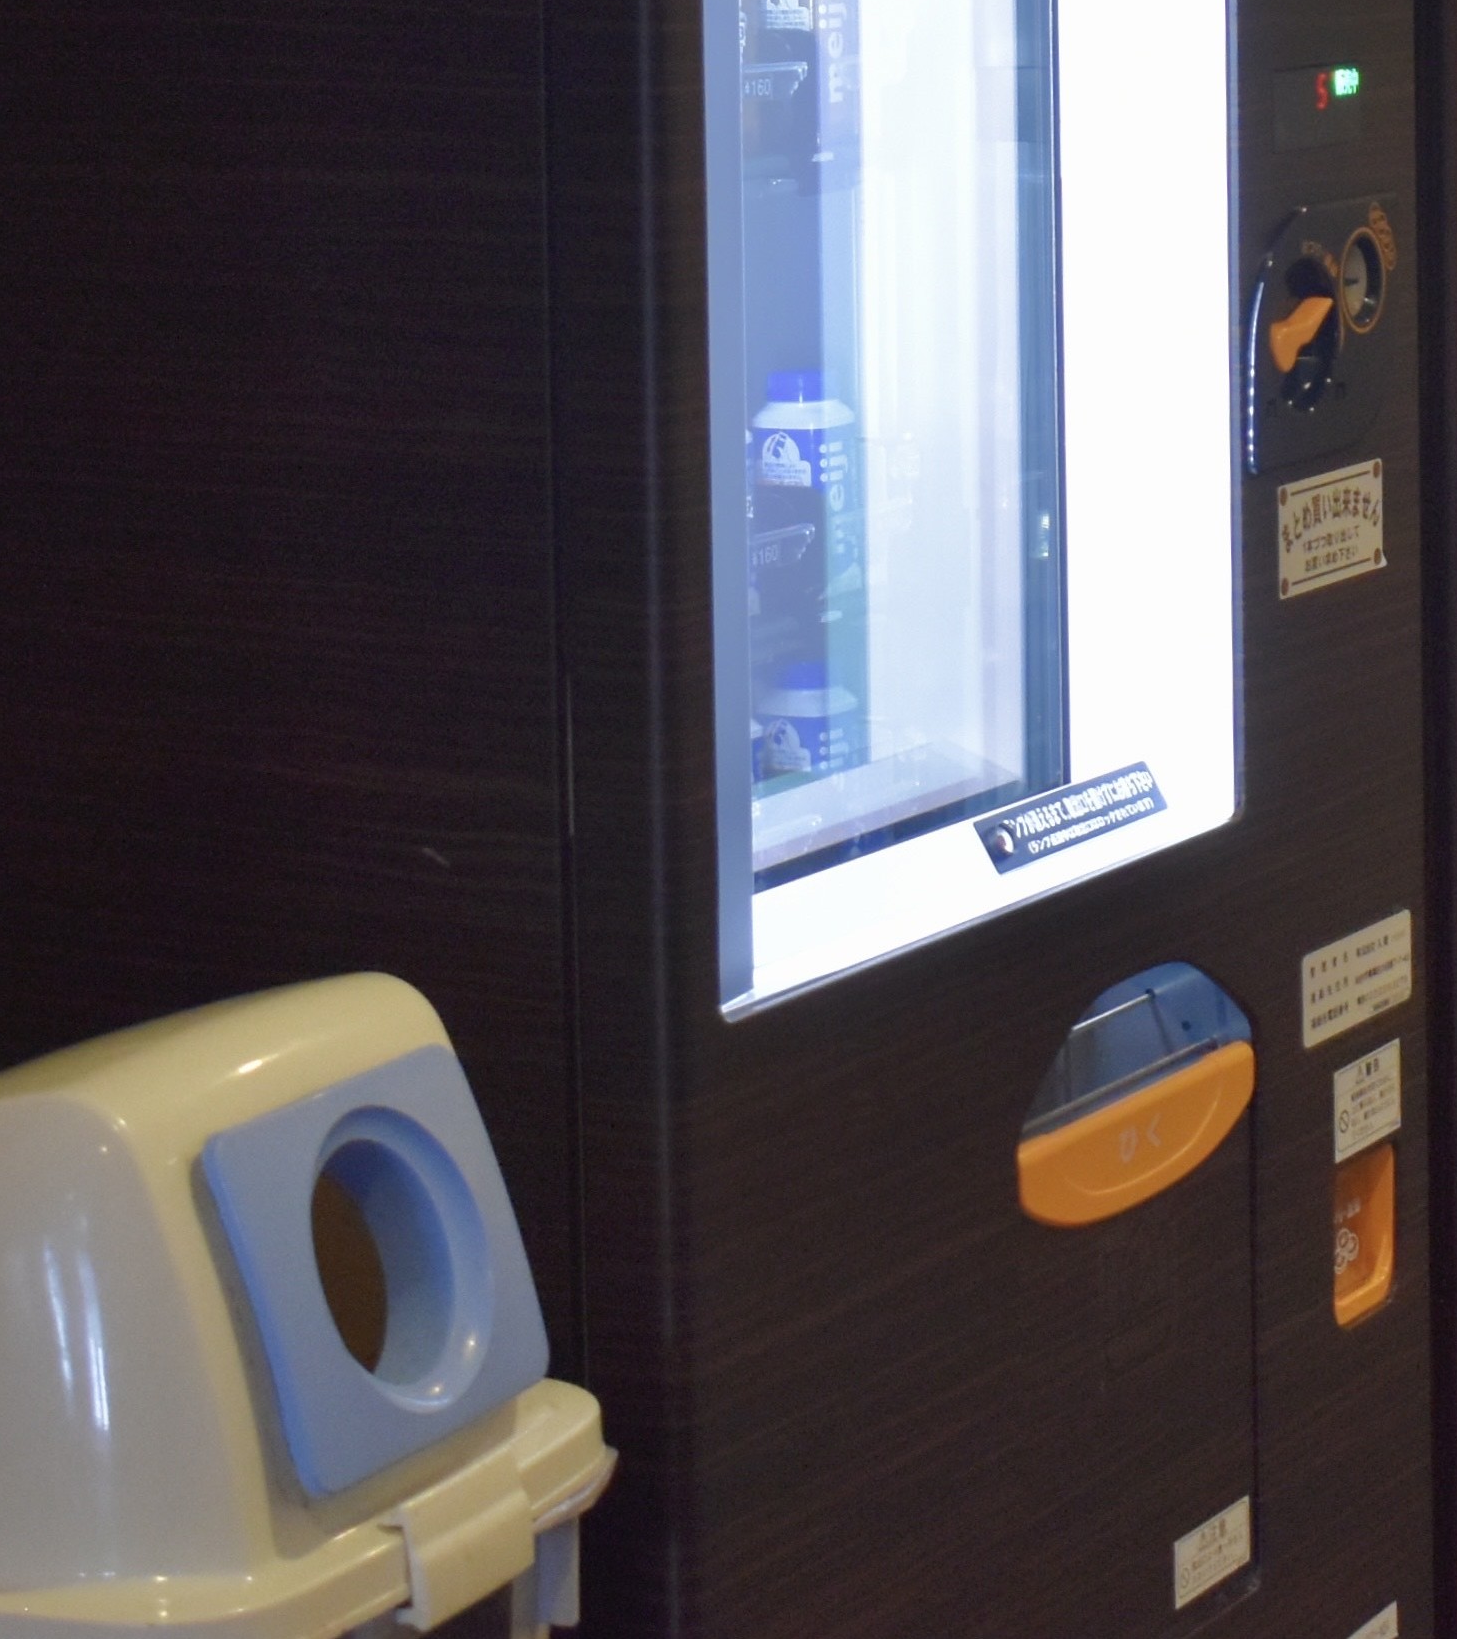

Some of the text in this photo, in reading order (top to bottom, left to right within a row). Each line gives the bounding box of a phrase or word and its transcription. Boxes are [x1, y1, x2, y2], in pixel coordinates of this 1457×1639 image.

[1281, 487, 1381, 555] まとめ買い出来ません
